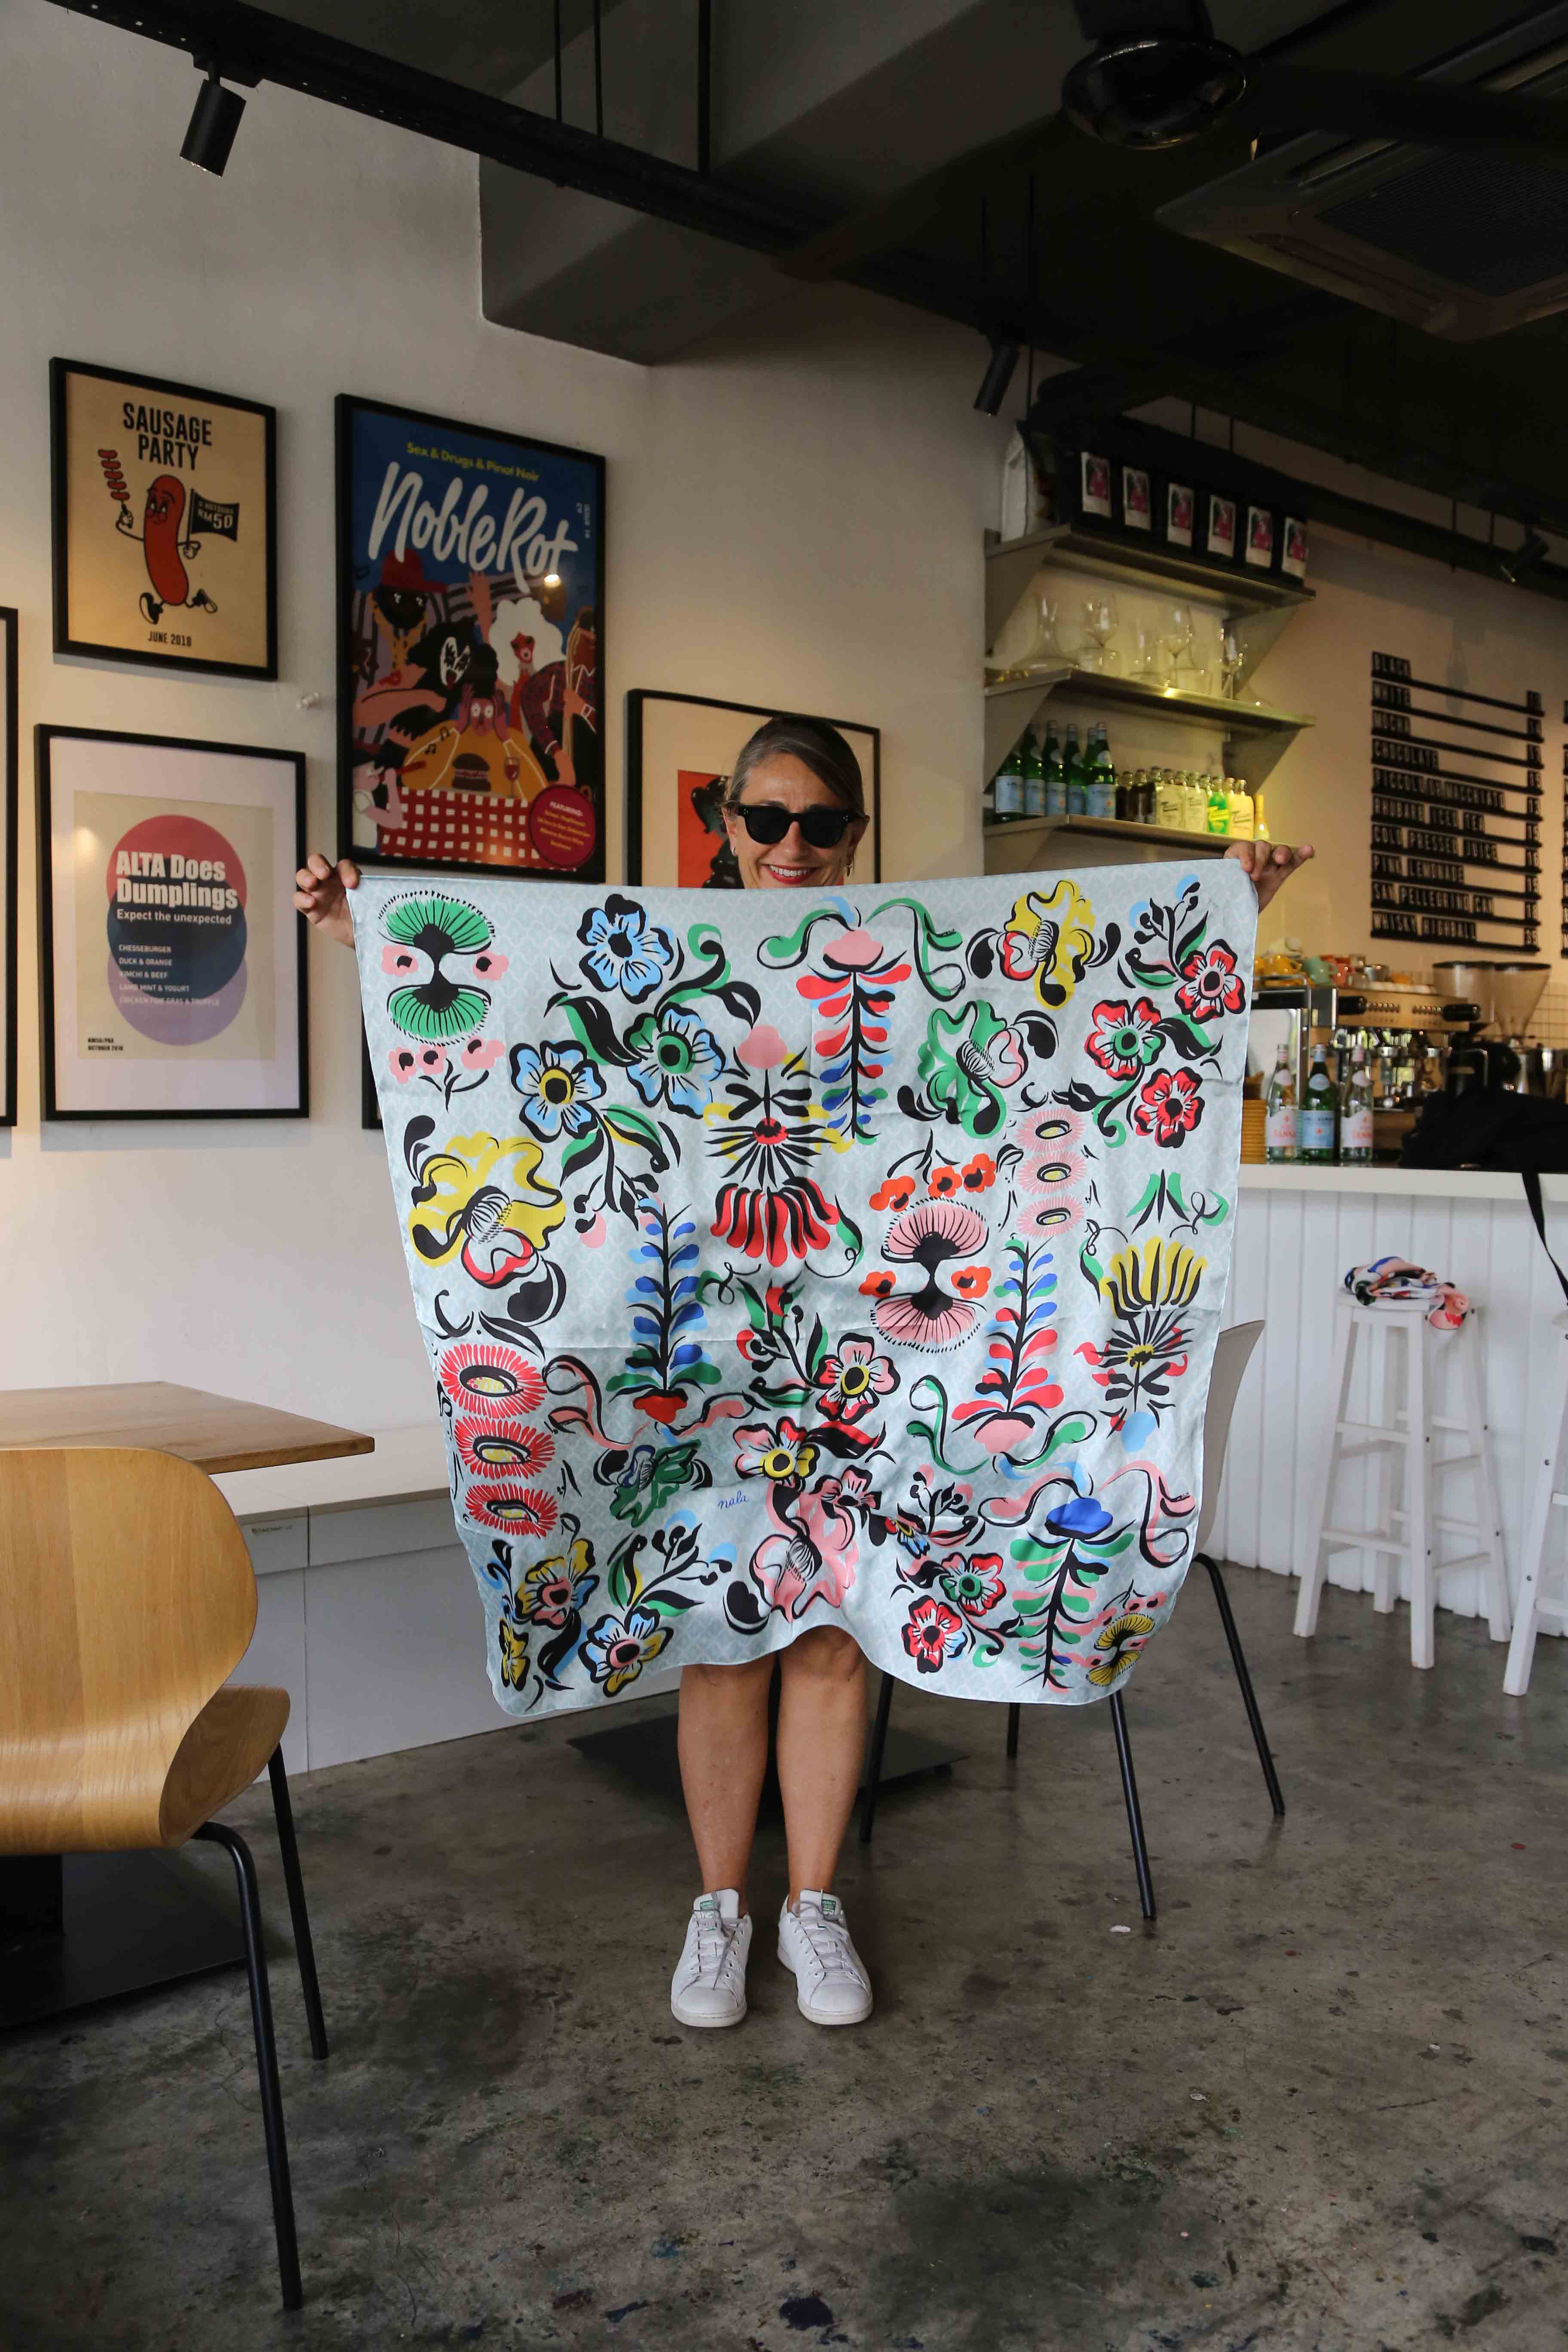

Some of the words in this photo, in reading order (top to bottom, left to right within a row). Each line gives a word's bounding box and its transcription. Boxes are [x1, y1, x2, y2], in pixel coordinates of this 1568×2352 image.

[123, 402, 211, 446] SAUSAGE
[138, 433, 199, 470] PARTY
[407, 441, 428, 456] Sex
[430, 447, 438, 458] &
[441, 450, 473, 468] Drugs
[476, 457, 484, 469] &
[487, 460, 514, 475] Pinot
[516, 467, 539, 481] Noir
[148, 631, 168, 643] JUNE
[171, 634, 192, 647] 2018
[1375, 653, 1410, 678] BLACK
[1374, 683, 1410, 707] WHITE
[1374, 710, 1410, 735] MOCHA
[1375, 741, 1437, 769] CHOCOLATE
[1375, 770, 1424, 793] PICCOLO
[1445, 781, 1504, 808] MACCHIATO
[1375, 798, 1424, 822] RHUBARB
[1465, 813, 1484, 833] TEA
[1375, 826, 1402, 846] COLD
[1410, 831, 1458, 854] PRESSED
[1466, 839, 1498, 861] JUICE
[116, 851, 165, 877] ALTA
[170, 854, 226, 882] Does
[1375, 854, 1402, 874] PINK
[1410, 859, 1464, 884] LEMONADE
[116, 878, 238, 911] Dumplings
[1375, 883, 1396, 902] SAN
[1401, 887, 1469, 912] PELLEGRINO
[116, 909, 152, 922] Expect
[155, 911, 171, 922] the
[174, 914, 232, 925] unexpected
[1375, 912, 1416, 932] WHISKY
[1423, 917, 1477, 940] HIGHBALL
[718, 1490, 749, 1510] nala
